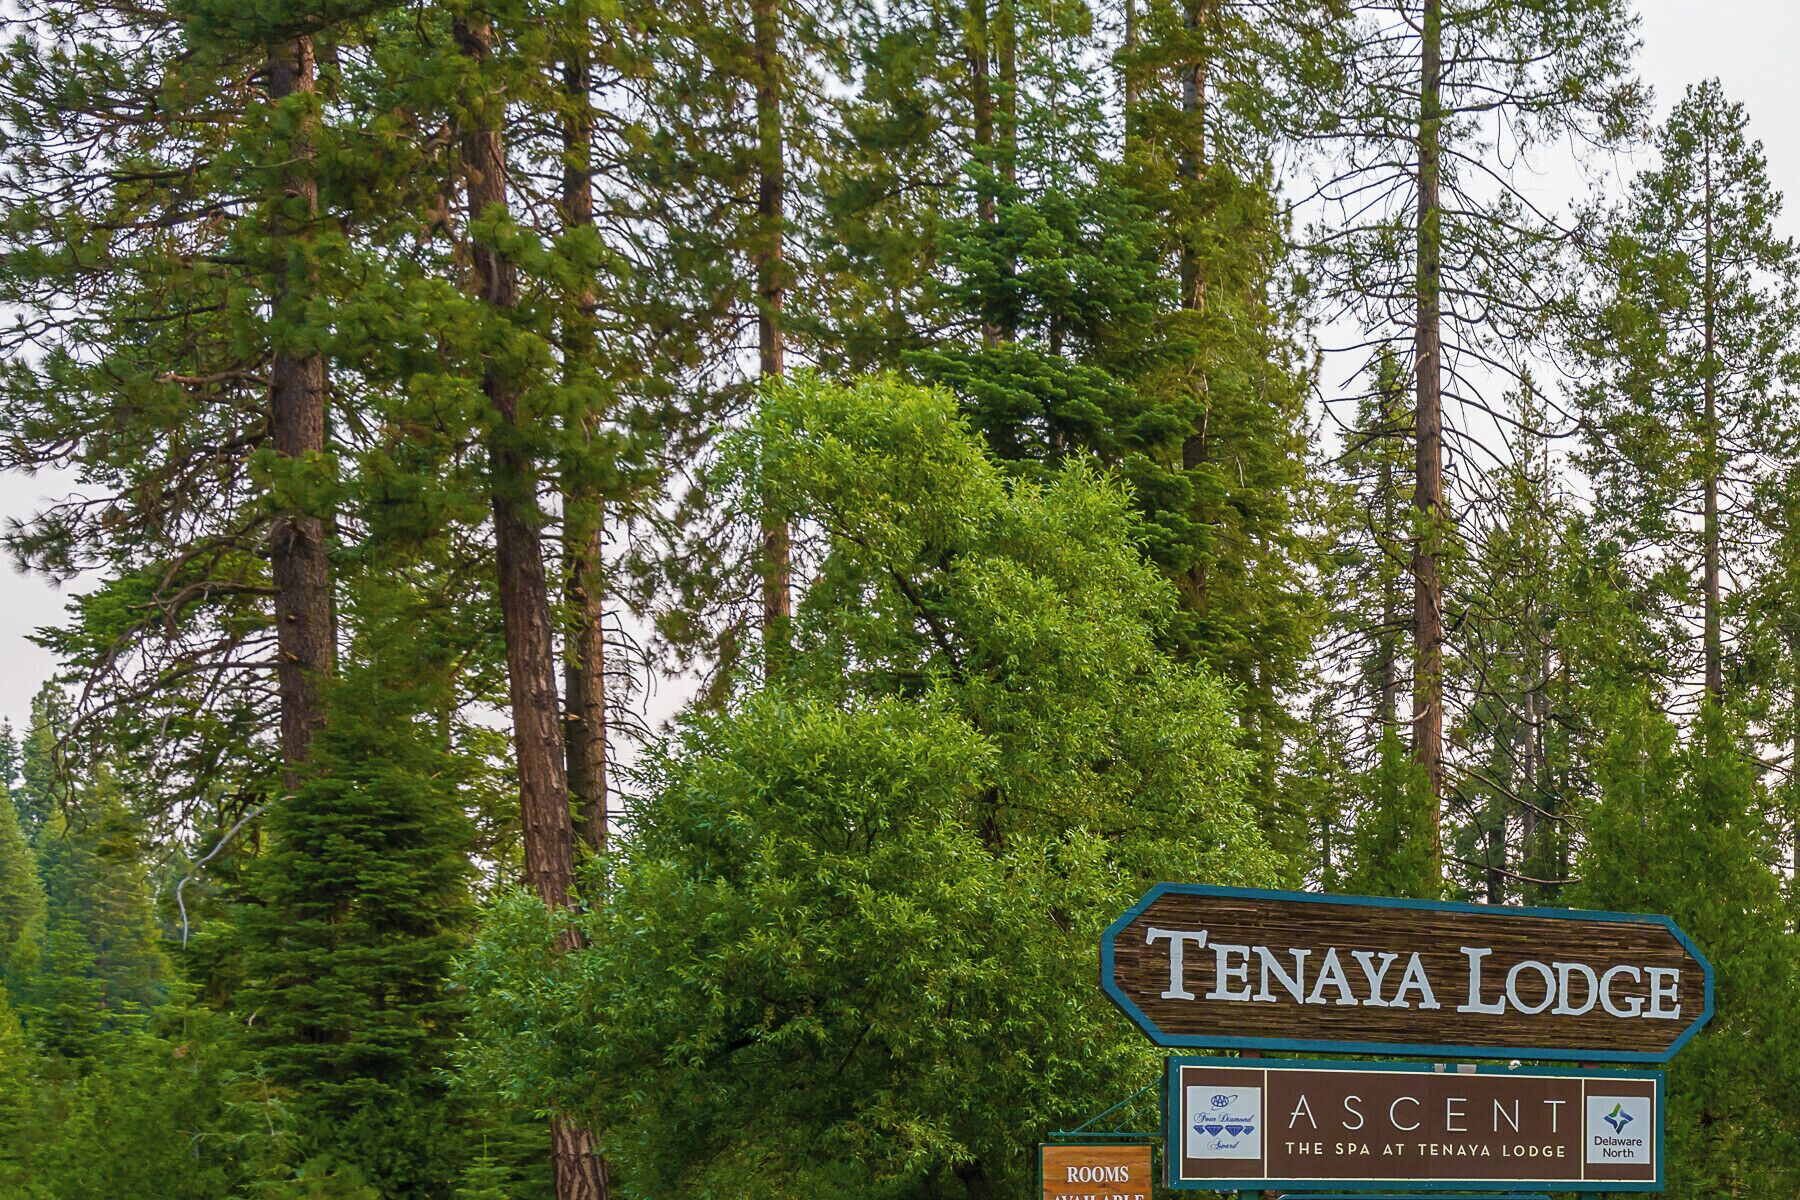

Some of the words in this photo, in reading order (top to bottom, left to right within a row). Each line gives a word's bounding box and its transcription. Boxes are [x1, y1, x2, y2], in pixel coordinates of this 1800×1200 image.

[1146, 928, 1441, 1009] TENAYA
[1457, 946, 1681, 1020] LODGE
[1218, 1112, 1254, 1123] Diamond
[1288, 1094, 1566, 1134] ASCENT
[1594, 1136, 1643, 1147] Delaware
[1285, 1142, 1323, 1155] THE
[1335, 1143, 1370, 1155] SPA
[1383, 1143, 1405, 1156] AT
[1418, 1143, 1491, 1157] TENAYA
[1502, 1145, 1566, 1158] LODGE
[1602, 1148, 1634, 1158] North
[1066, 1166, 1129, 1183] ROOMS
